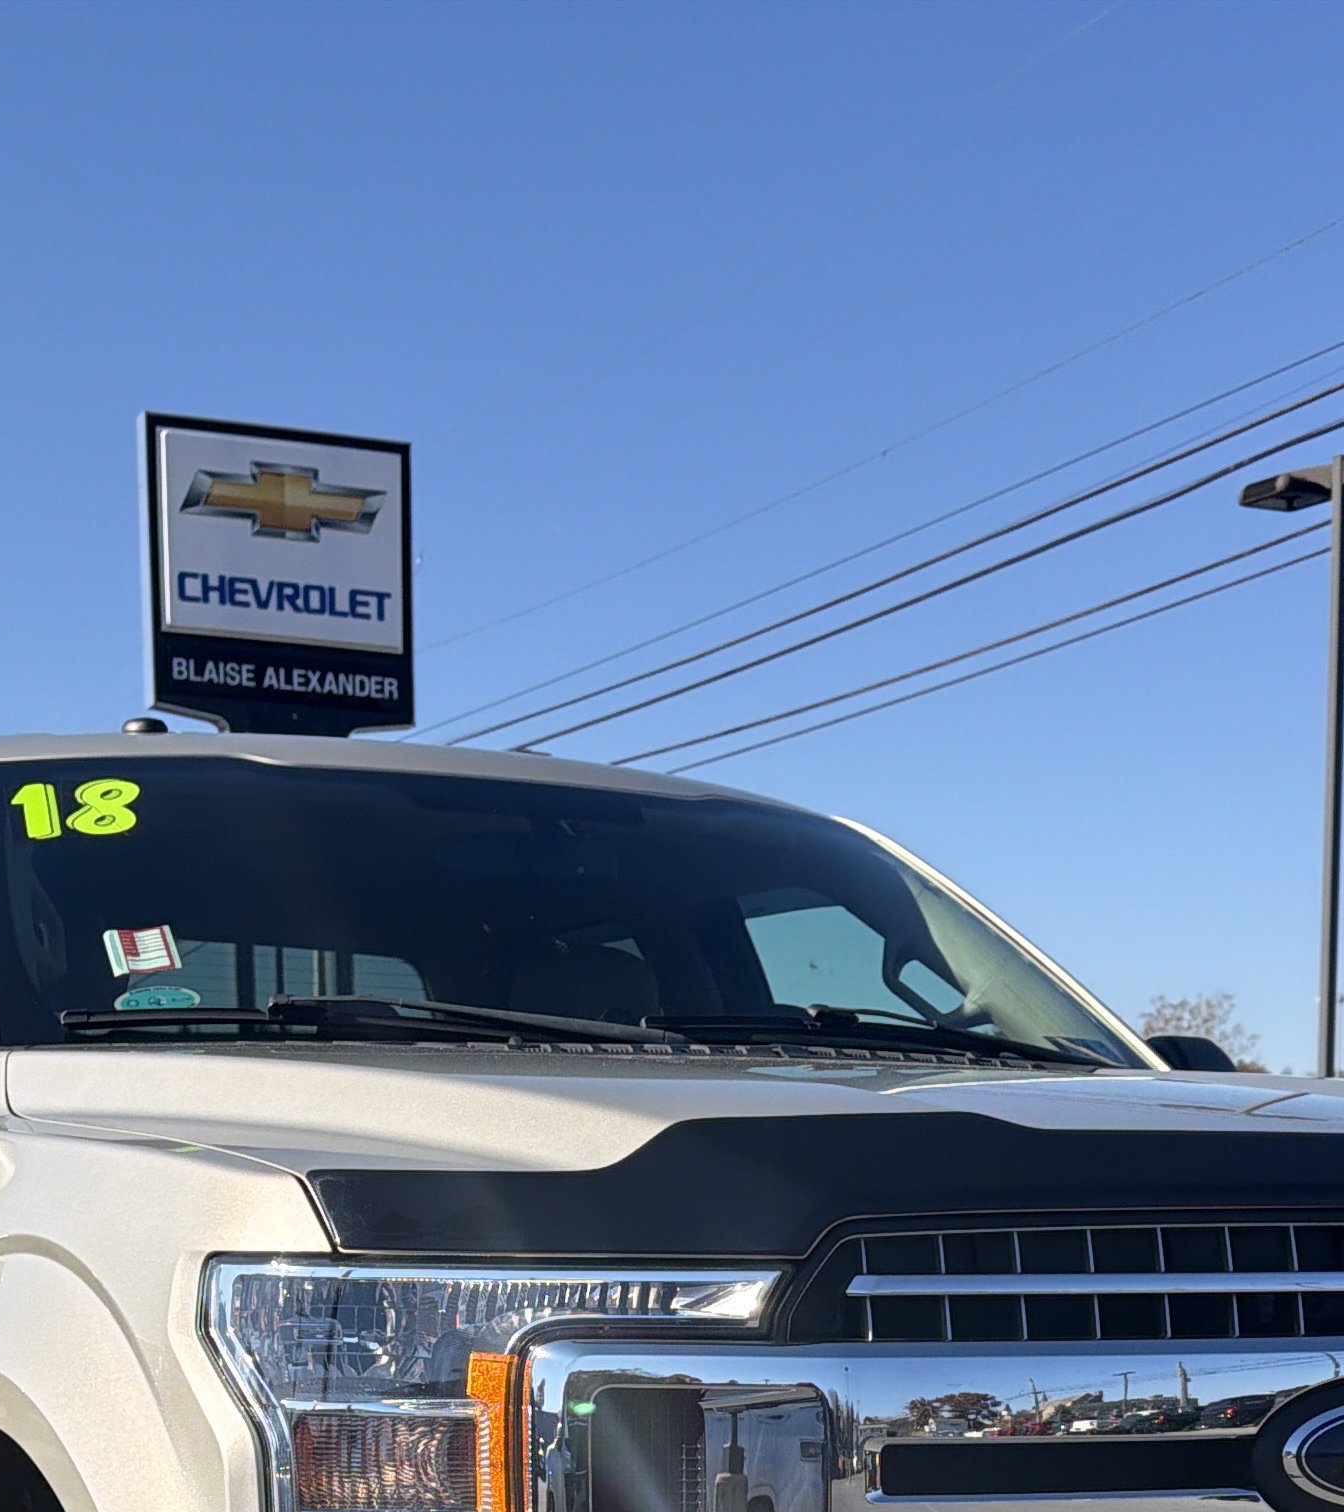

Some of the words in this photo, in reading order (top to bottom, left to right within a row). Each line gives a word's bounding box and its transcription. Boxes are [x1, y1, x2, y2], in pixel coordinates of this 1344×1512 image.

[177, 571, 392, 621] CHEVROLET
[172, 656, 256, 688] BLAISE
[262, 665, 399, 701] ALEXANDER
[10, 778, 141, 840] 18
